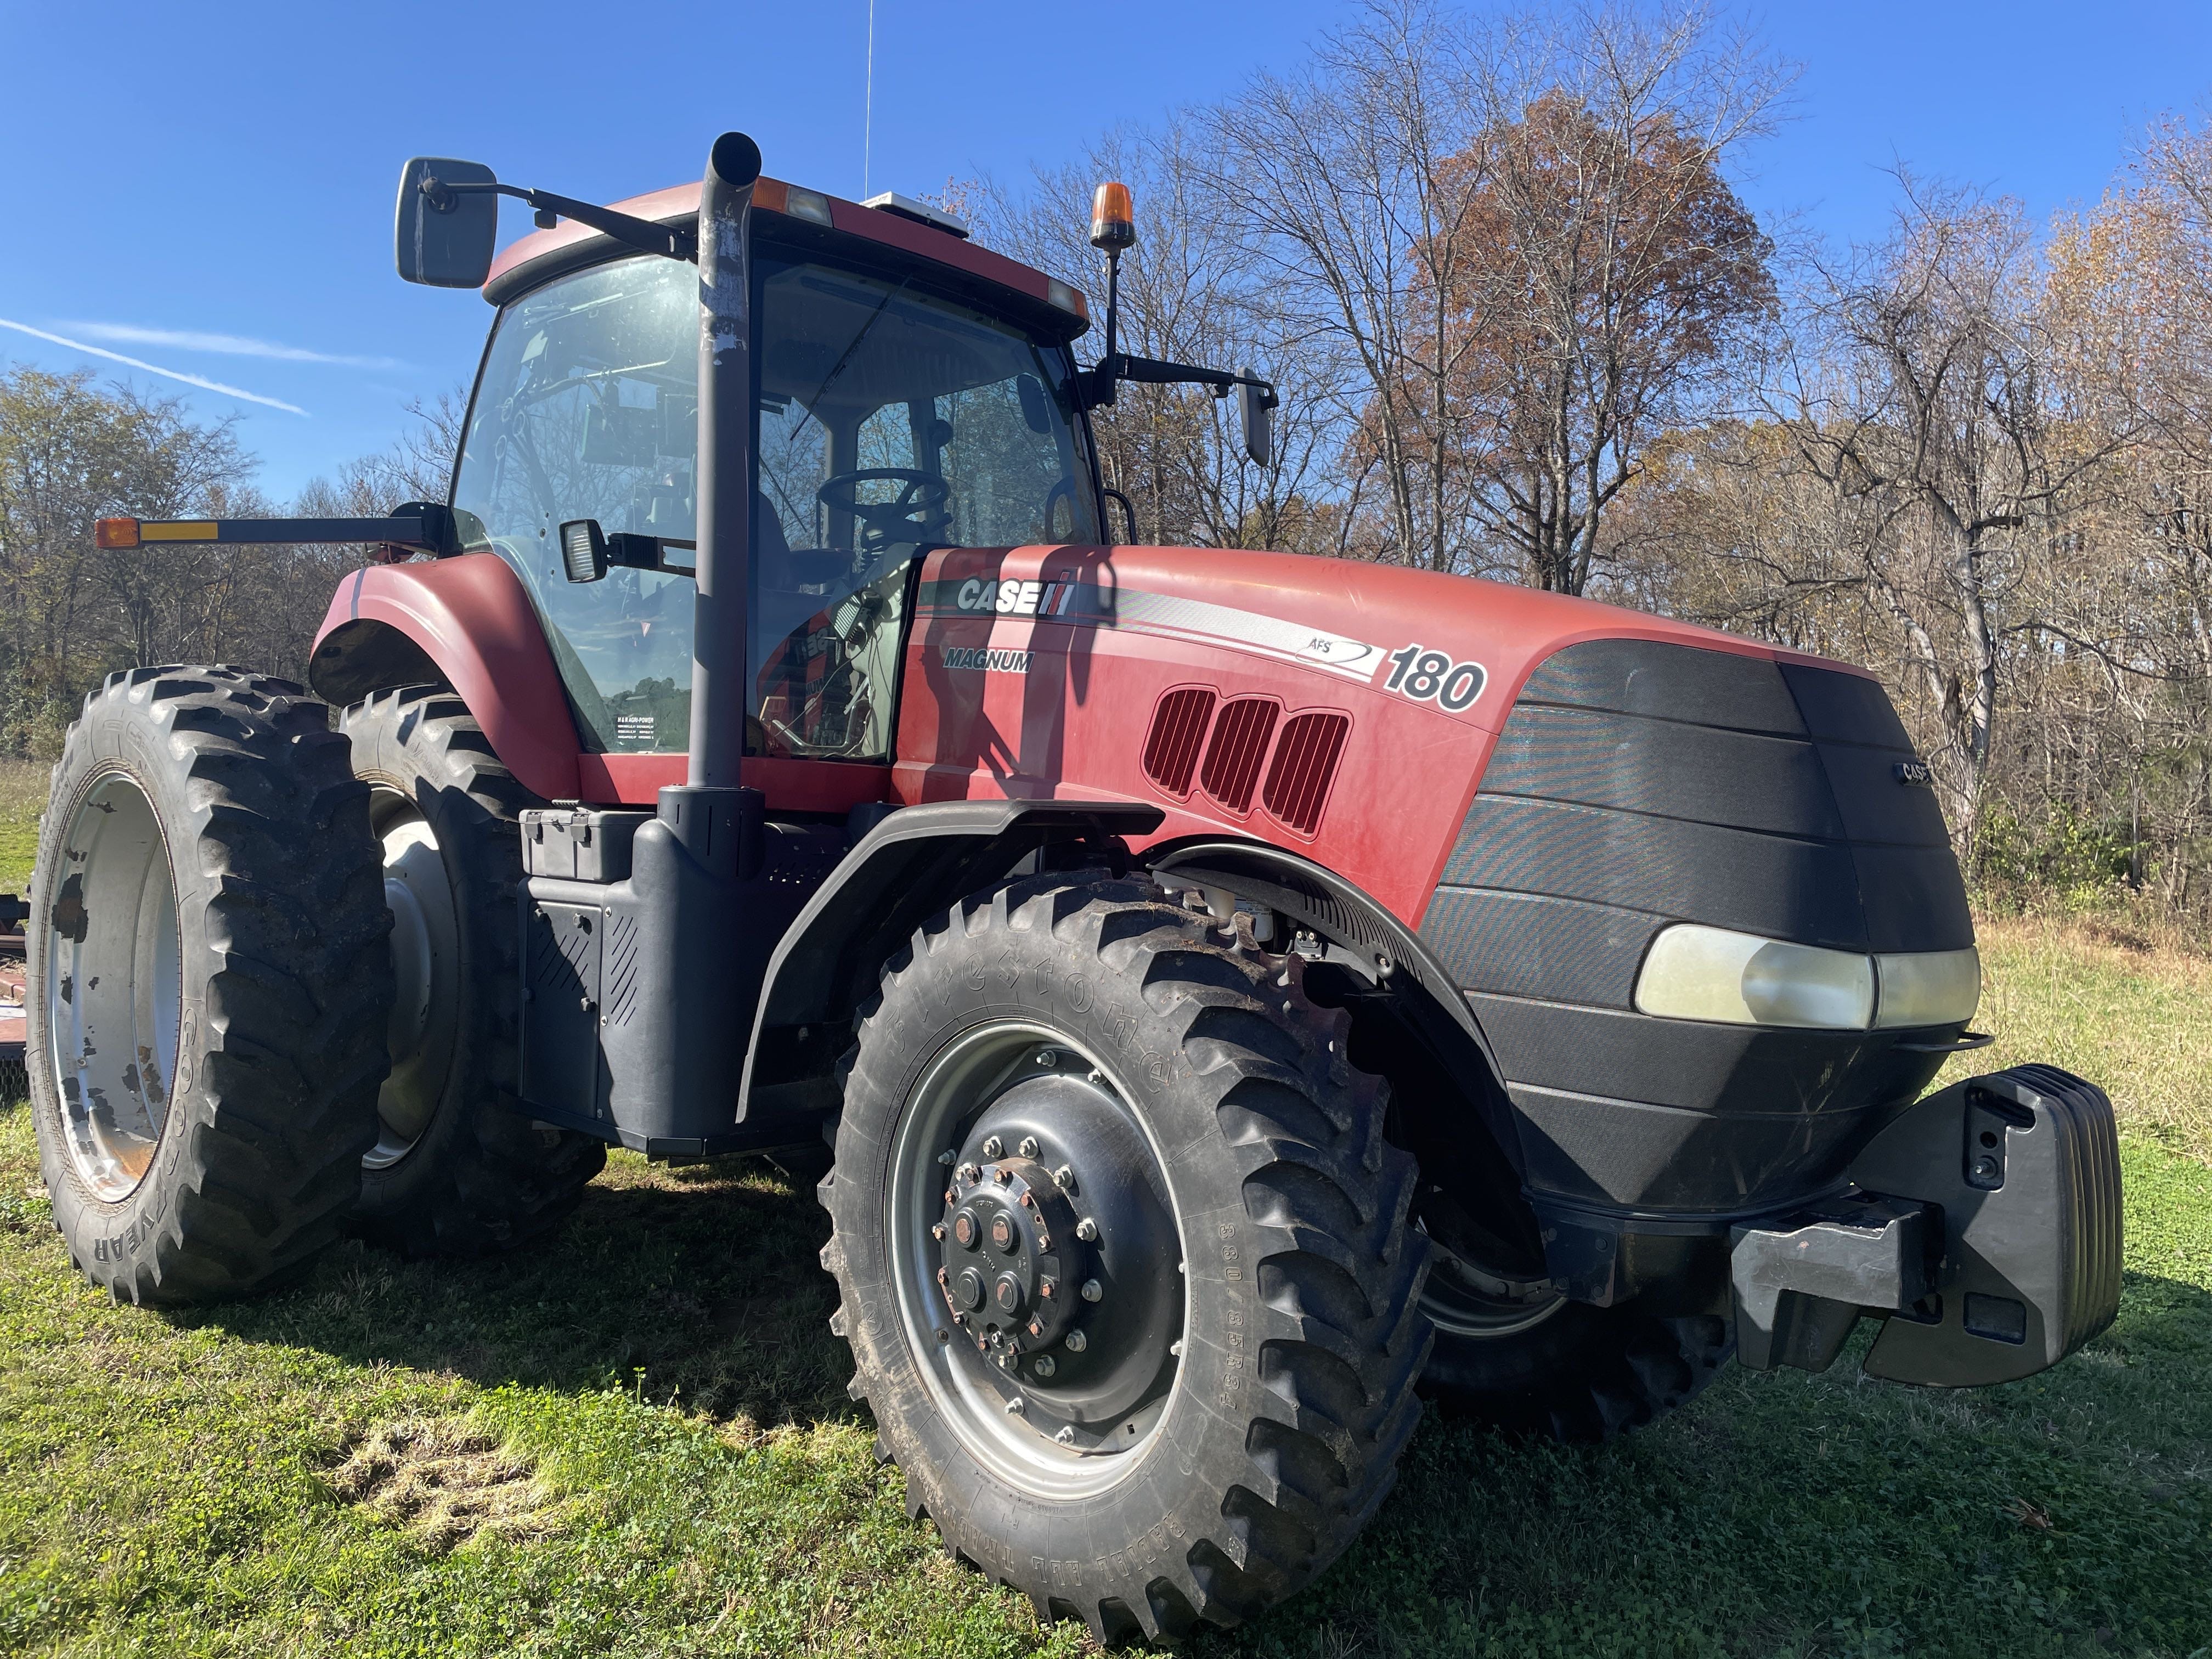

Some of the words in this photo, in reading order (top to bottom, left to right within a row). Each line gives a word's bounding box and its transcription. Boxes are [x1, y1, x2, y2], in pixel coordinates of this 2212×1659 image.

[958, 579, 1042, 614] CASE
[943, 647, 1036, 674] MAGNUM
[1308, 636, 1331, 653] AFS
[1383, 642, 1488, 713] 180
[885, 949, 1172, 1094] Firestone
[1219, 1223, 1244, 1410] 380/85R34
[1032, 1556, 1083, 1587] ALL
[1096, 1510, 1187, 1583] RADIAL
